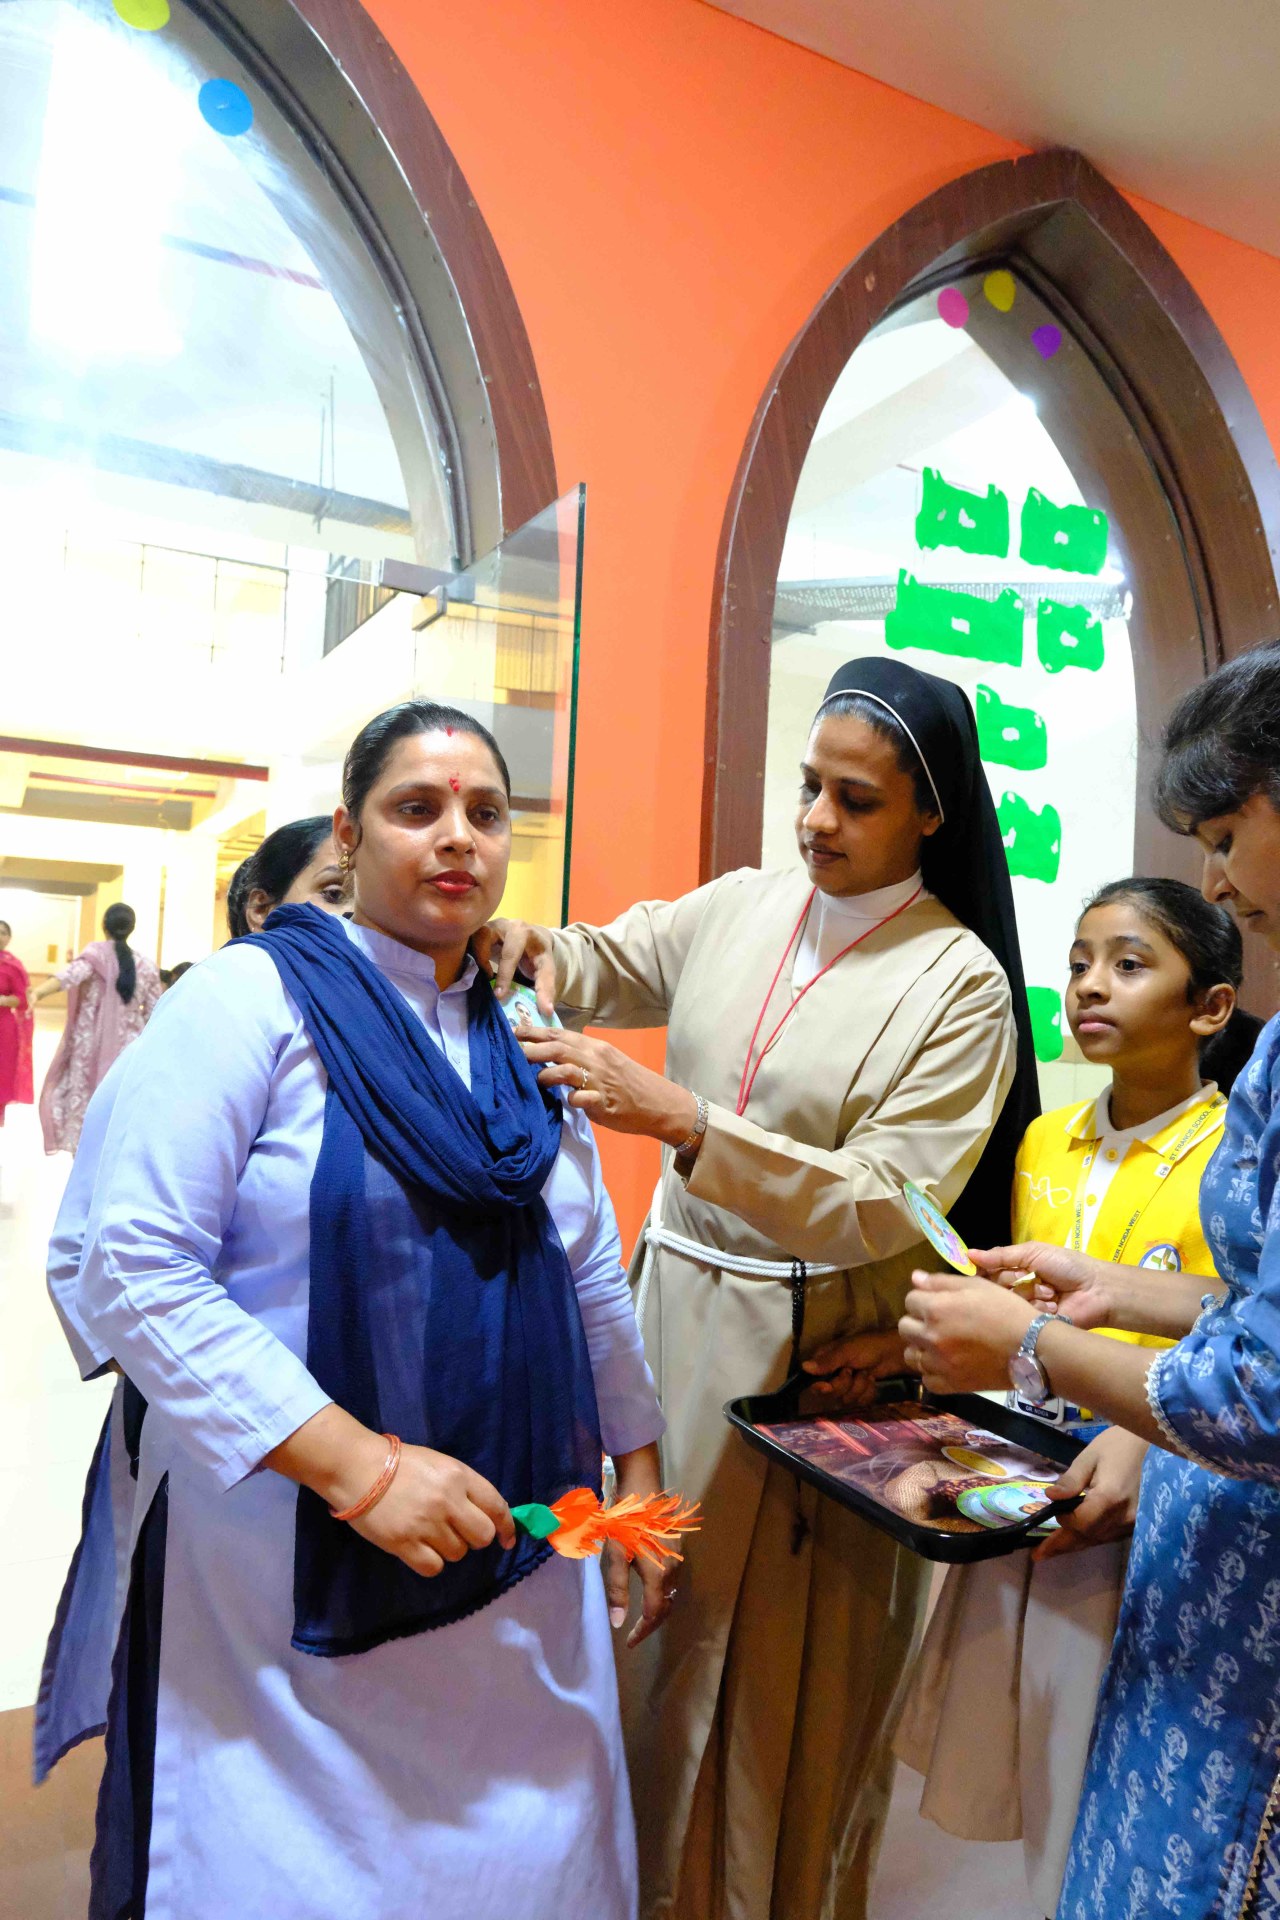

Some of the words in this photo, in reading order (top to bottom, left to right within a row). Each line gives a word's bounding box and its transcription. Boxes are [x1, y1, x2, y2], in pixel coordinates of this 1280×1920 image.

[1175, 1129, 1195, 1152] FRANCIS
[1192, 1110, 1212, 1128] SCHOOL
[1112, 1248, 1121, 1262] TER
[1118, 1228, 1131, 1248] NOIDA
[1128, 1210, 1140, 1227] WEST
